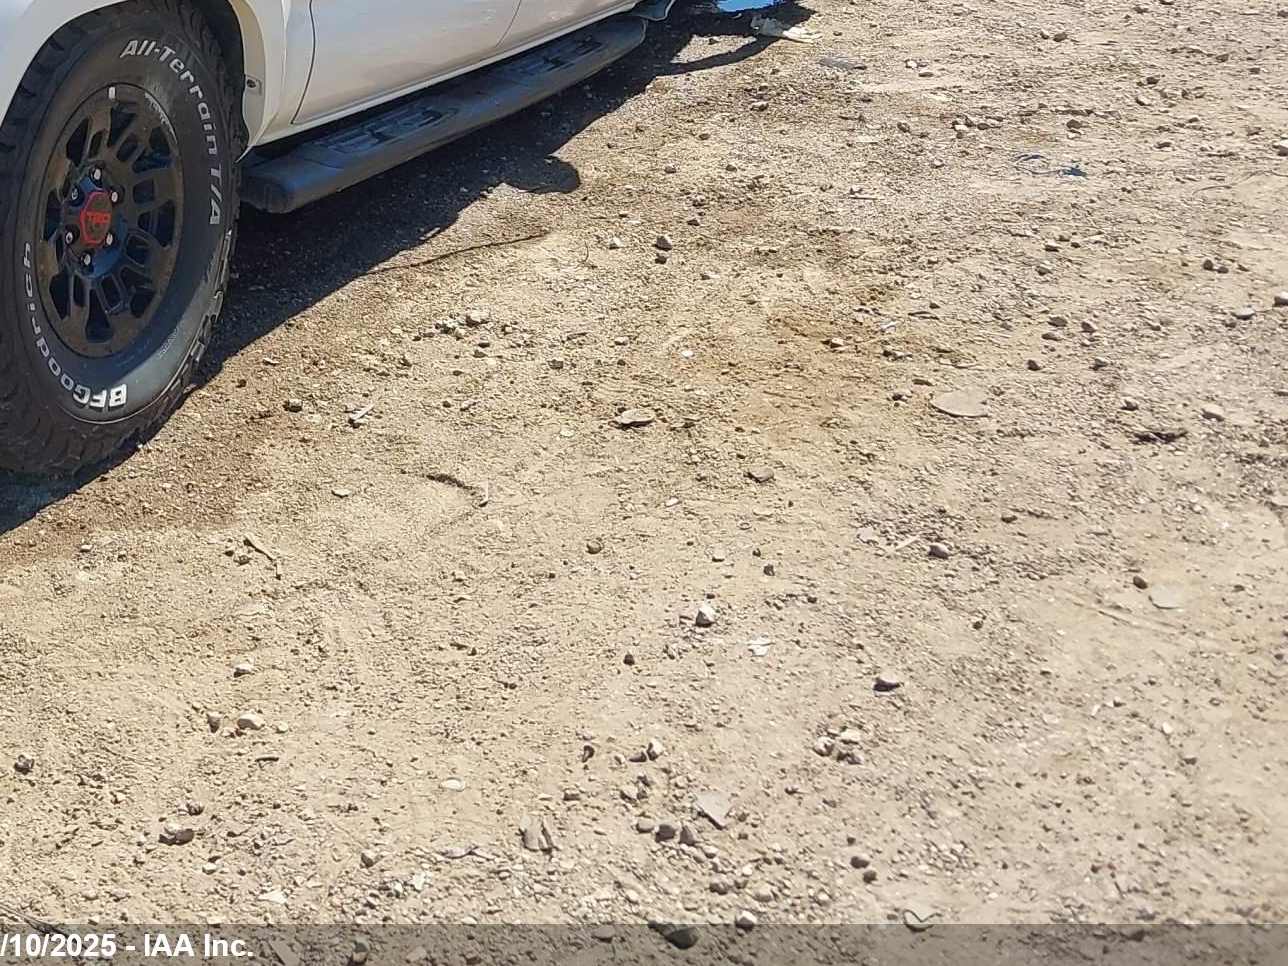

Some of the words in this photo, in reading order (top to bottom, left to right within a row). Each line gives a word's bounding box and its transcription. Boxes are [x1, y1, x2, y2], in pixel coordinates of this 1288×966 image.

[119, 40, 217, 155] All-Terrain
[210, 163, 222, 225] T/A
[23, 242, 128, 408] BFGoodrich
